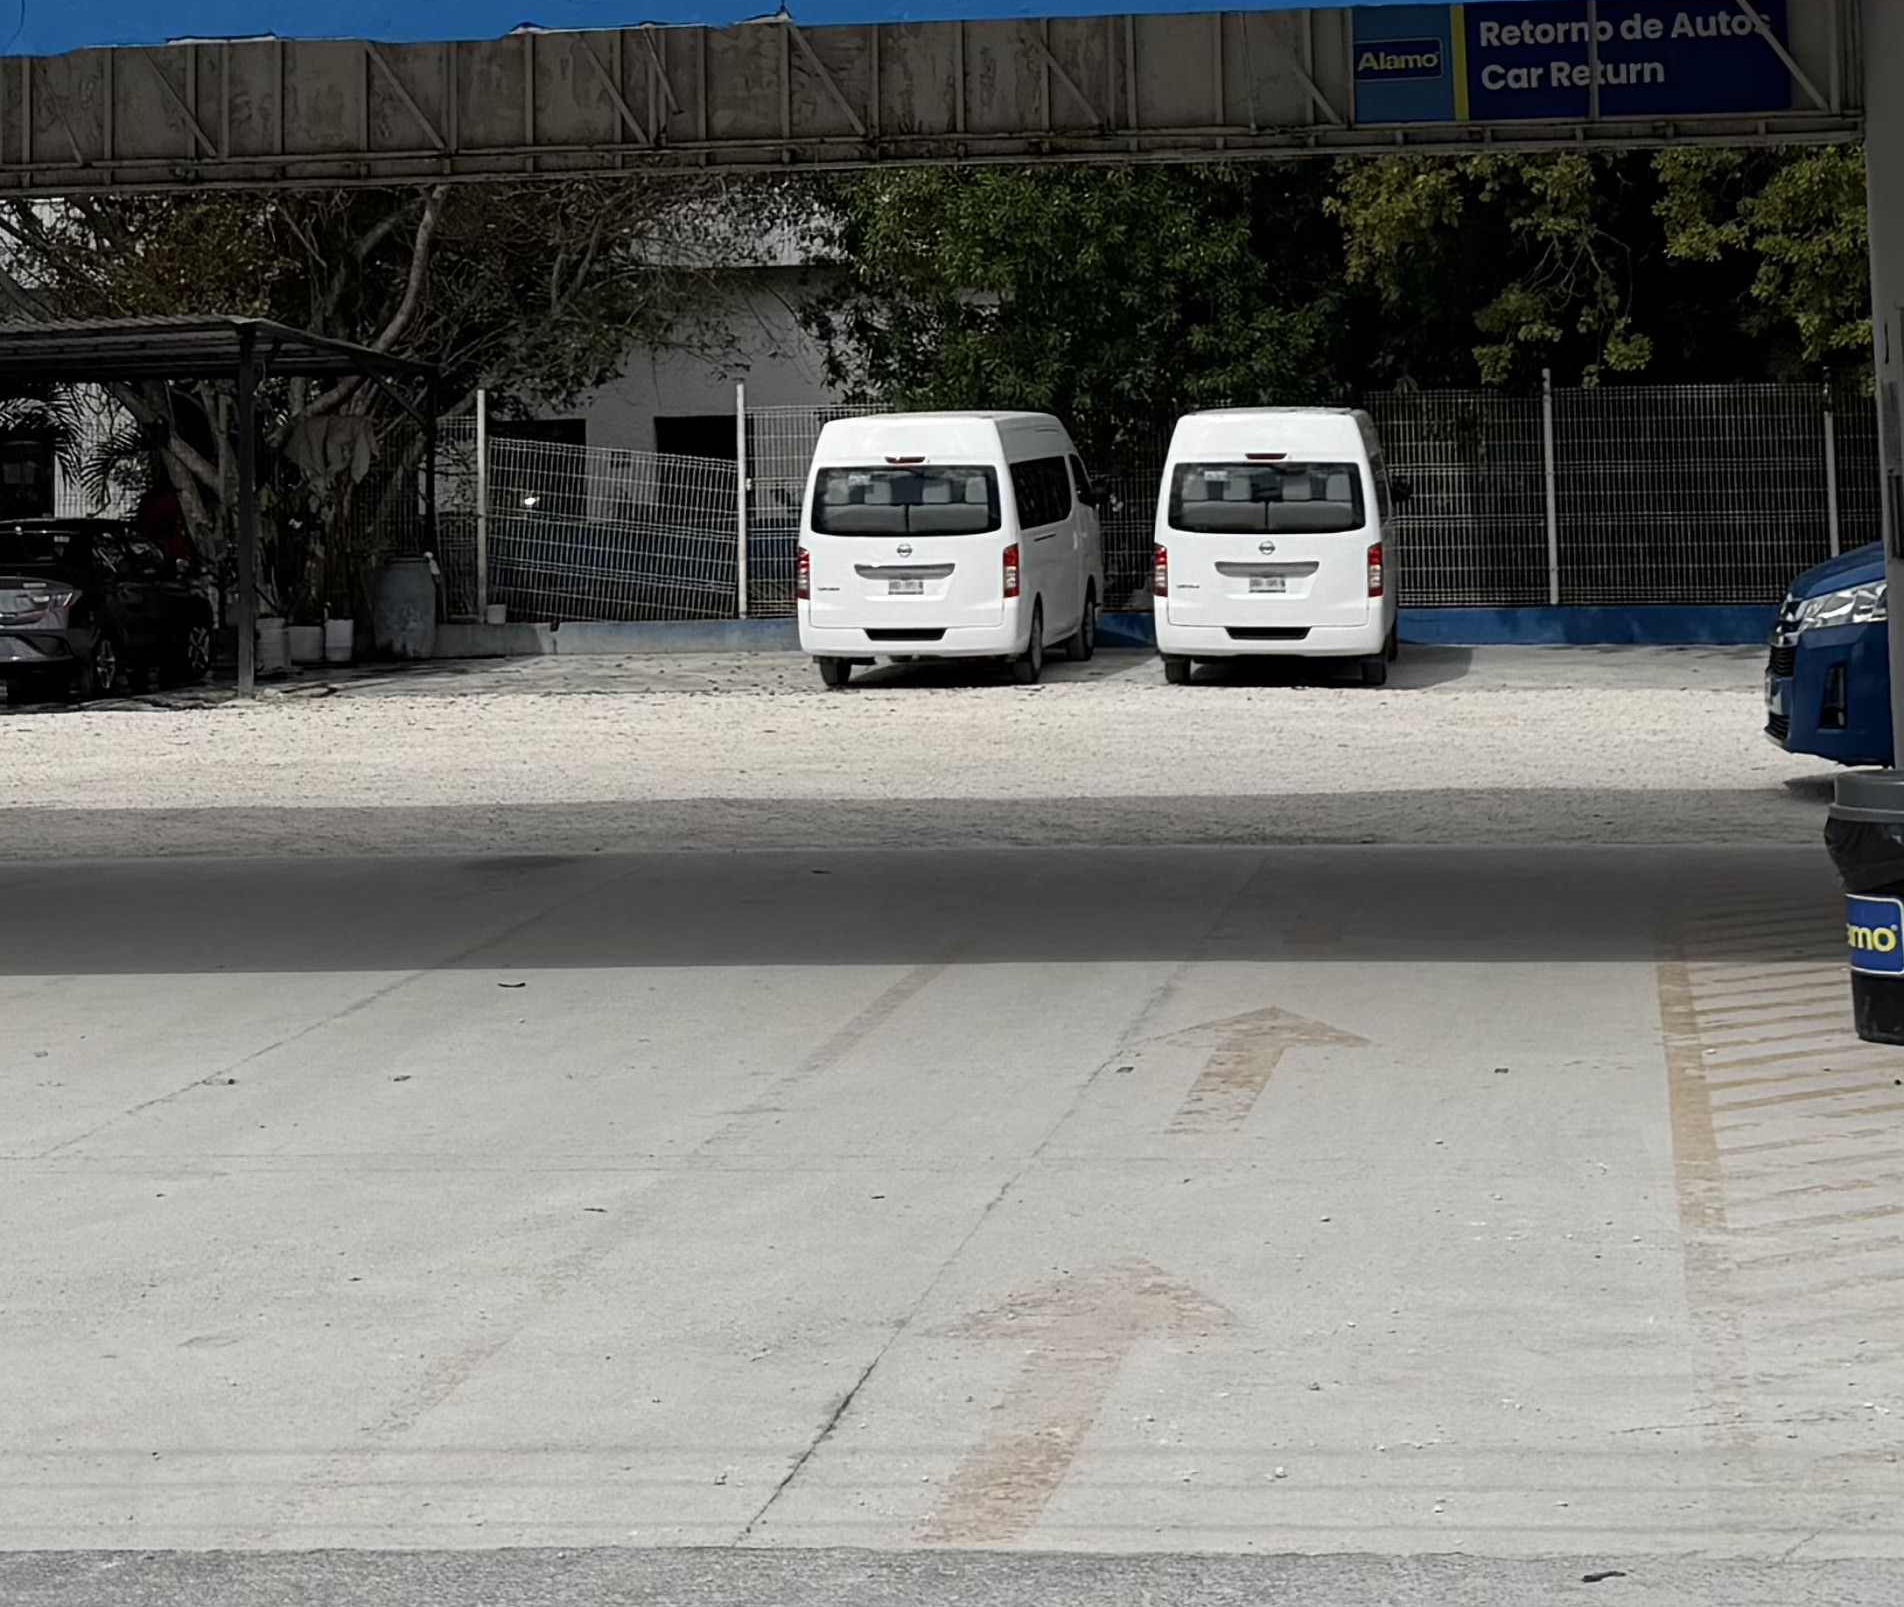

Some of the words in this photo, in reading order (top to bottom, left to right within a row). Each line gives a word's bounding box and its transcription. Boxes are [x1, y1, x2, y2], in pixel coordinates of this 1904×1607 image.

[1480, 19, 1614, 47] Retorno
[1619, 12, 1663, 41] de
[1356, 50, 1439, 72] Alamo
[1481, 64, 1543, 91] Car
[1549, 58, 1665, 87] Return
